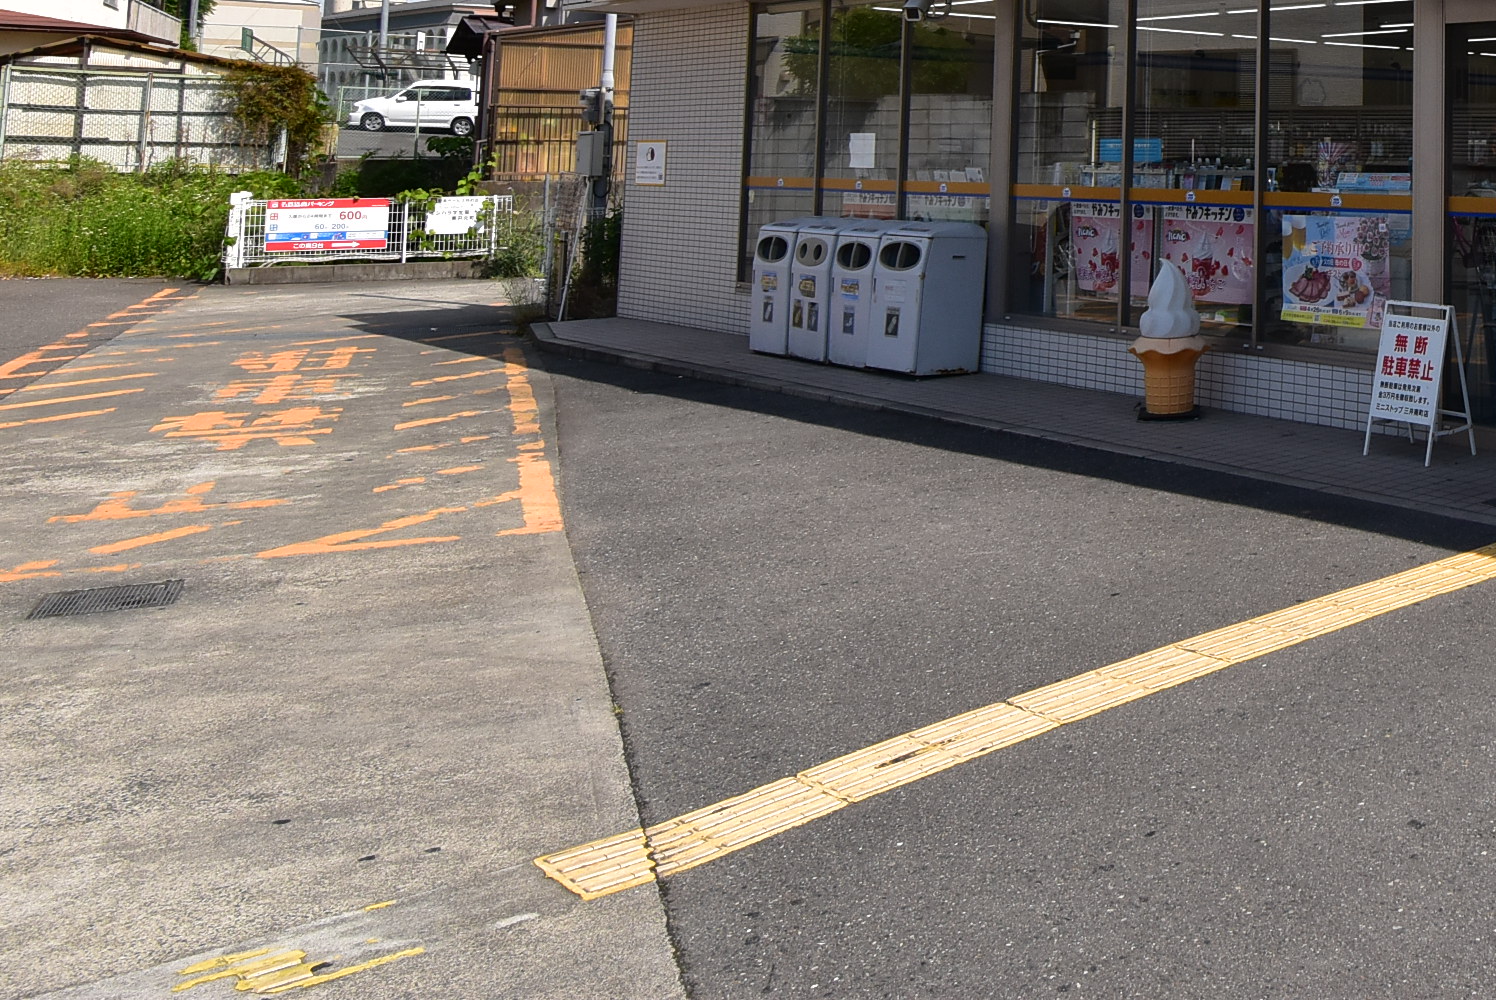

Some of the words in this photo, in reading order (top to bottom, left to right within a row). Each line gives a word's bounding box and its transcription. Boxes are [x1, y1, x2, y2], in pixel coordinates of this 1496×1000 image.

[1092, 203, 1120, 217] やみつキッ
[1186, 206, 1232, 222] やみつキッチン
[1394, 333, 1428, 355] 無断
[1381, 355, 1434, 381] 駐車禁止
